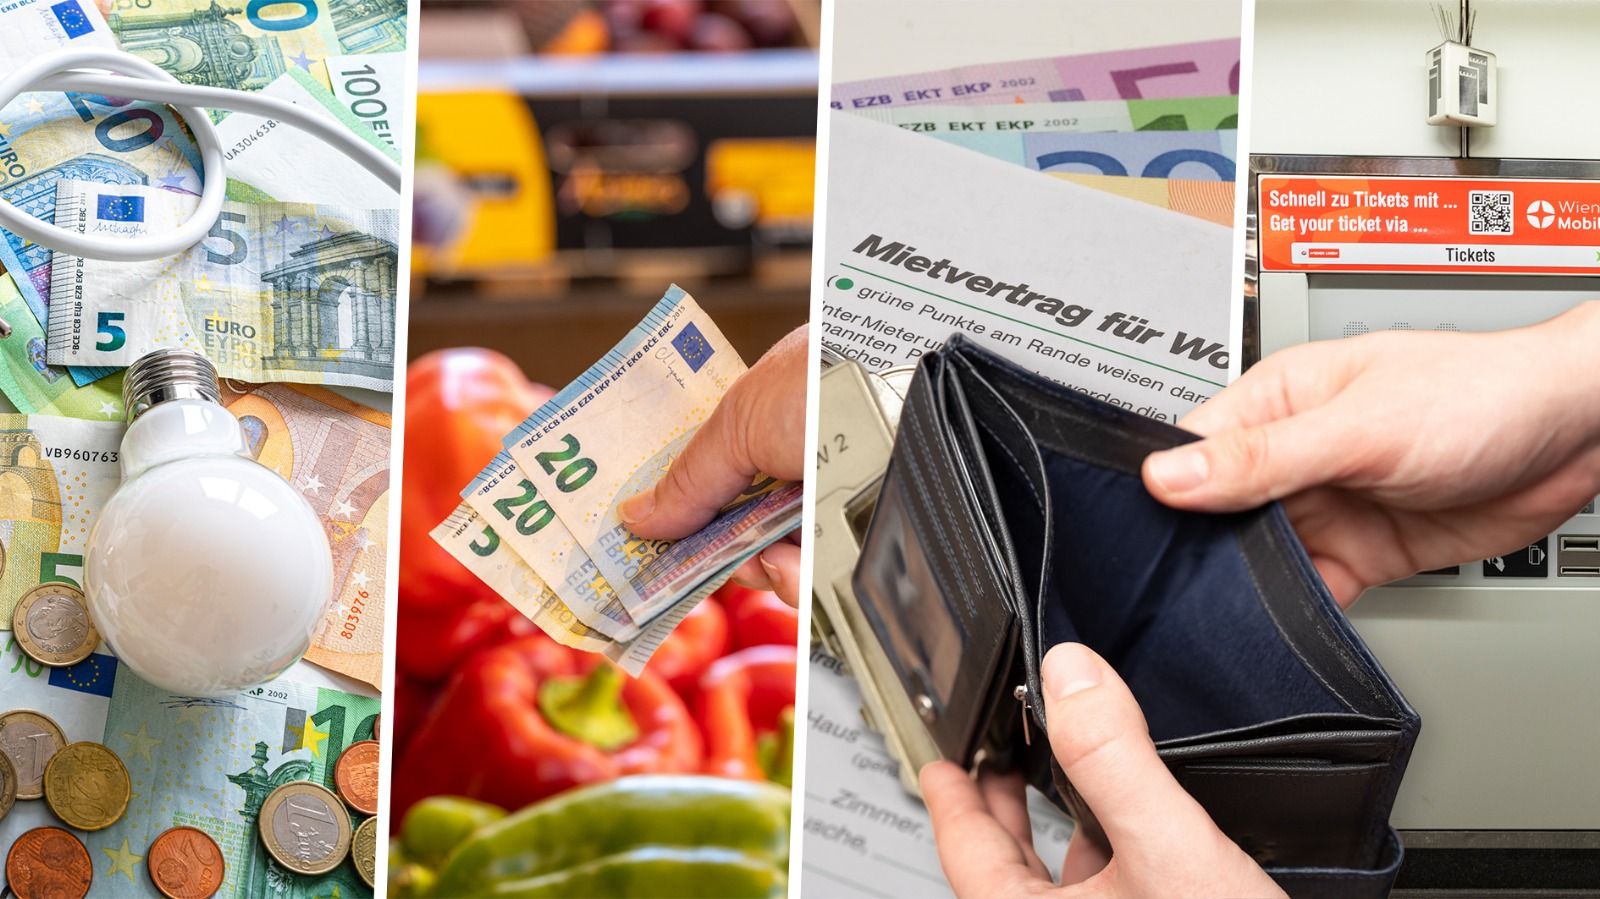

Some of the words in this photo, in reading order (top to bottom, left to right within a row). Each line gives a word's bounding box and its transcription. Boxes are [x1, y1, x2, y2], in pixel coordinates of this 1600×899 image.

[852, 94, 892, 109] EZB
[904, 88, 942, 102] EKT
[951, 82, 991, 96] EKP
[1000, 77, 1036, 88] 2002
[949, 121, 986, 131] EKT
[996, 120, 1034, 131] EKP
[1044, 118, 1079, 127] 2002
[223, 119, 281, 161] UA304638
[1269, 190, 1326, 207] Schnell
[1331, 194, 1349, 207] zu
[1353, 191, 1409, 208] Tickets
[1414, 192, 1439, 208] mit
[1270, 215, 1296, 231] Get
[1299, 217, 1333, 235] your
[1338, 216, 1381, 232] ticket
[1386, 217, 1408, 232] via
[208, 211, 248, 266] 5
[1445, 247, 1496, 263] Tickets
[76, 269, 84, 283] EKP
[75, 285, 83, 299] EZB
[852, 234, 1094, 328] Mietvertrag
[1096, 311, 1165, 345] für
[73, 318, 81, 333] ECB
[96, 312, 126, 352] 5
[204, 318, 256, 339] EURO
[860, 315, 924, 345] Mieter
[857, 287, 914, 311] grüne
[918, 304, 986, 335] Punkte
[990, 328, 1022, 347] am
[1026, 338, 1091, 369] Rande
[1096, 361, 1165, 392] weisen
[543, 418, 561, 434] ECB
[577, 392, 595, 408] EZB
[594, 379, 611, 395] EKP
[610, 365, 628, 382] EKT
[626, 350, 643, 368] EKB
[657, 320, 674, 338] EBC
[672, 305, 686, 321] 2015
[834, 433, 848, 453] 2
[45, 447, 119, 463] VB960763
[535, 433, 598, 493] 20
[498, 463, 516, 480] ECB
[493, 478, 556, 536] 20
[340, 590, 369, 640] 803976
[267, 689, 288, 700] 2002
